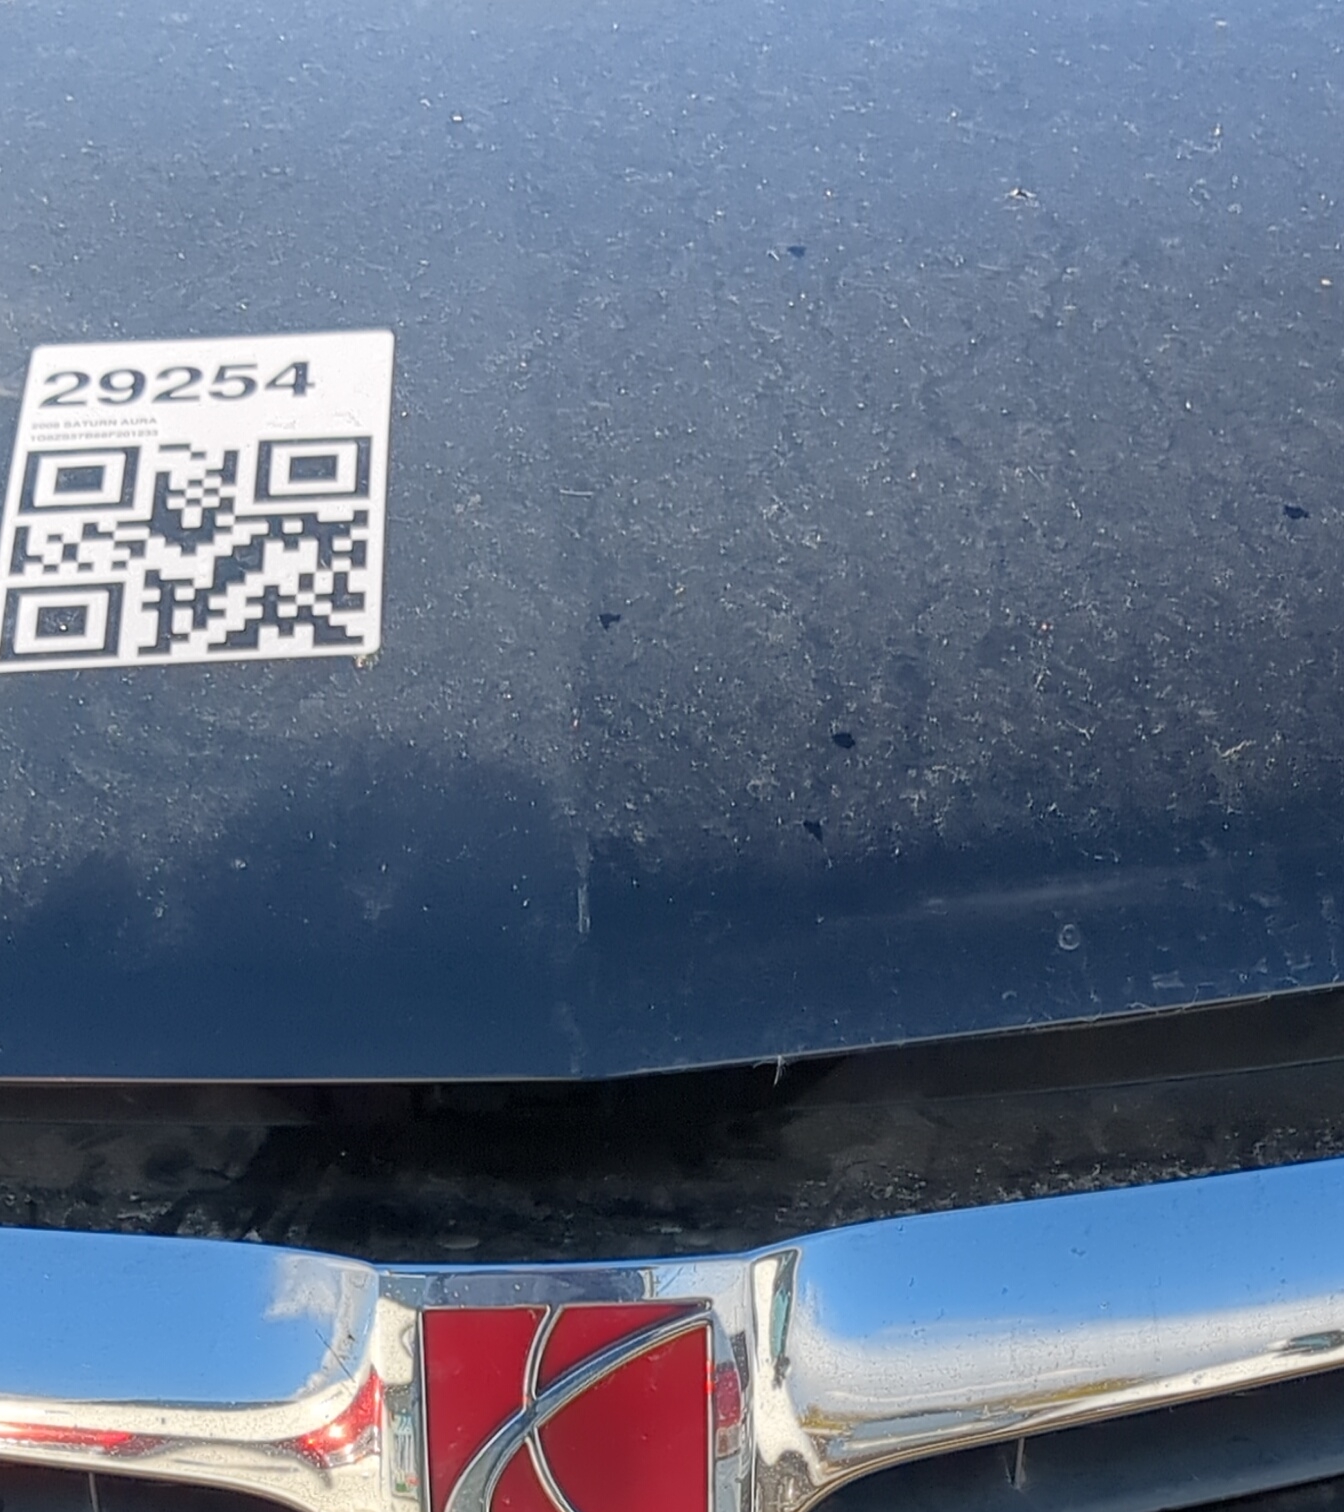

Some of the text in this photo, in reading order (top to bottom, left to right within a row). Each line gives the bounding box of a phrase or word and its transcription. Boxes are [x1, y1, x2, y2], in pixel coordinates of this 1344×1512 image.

[38, 361, 316, 408] 29254
[31, 417, 158, 430] 2008 SATURN AURA
